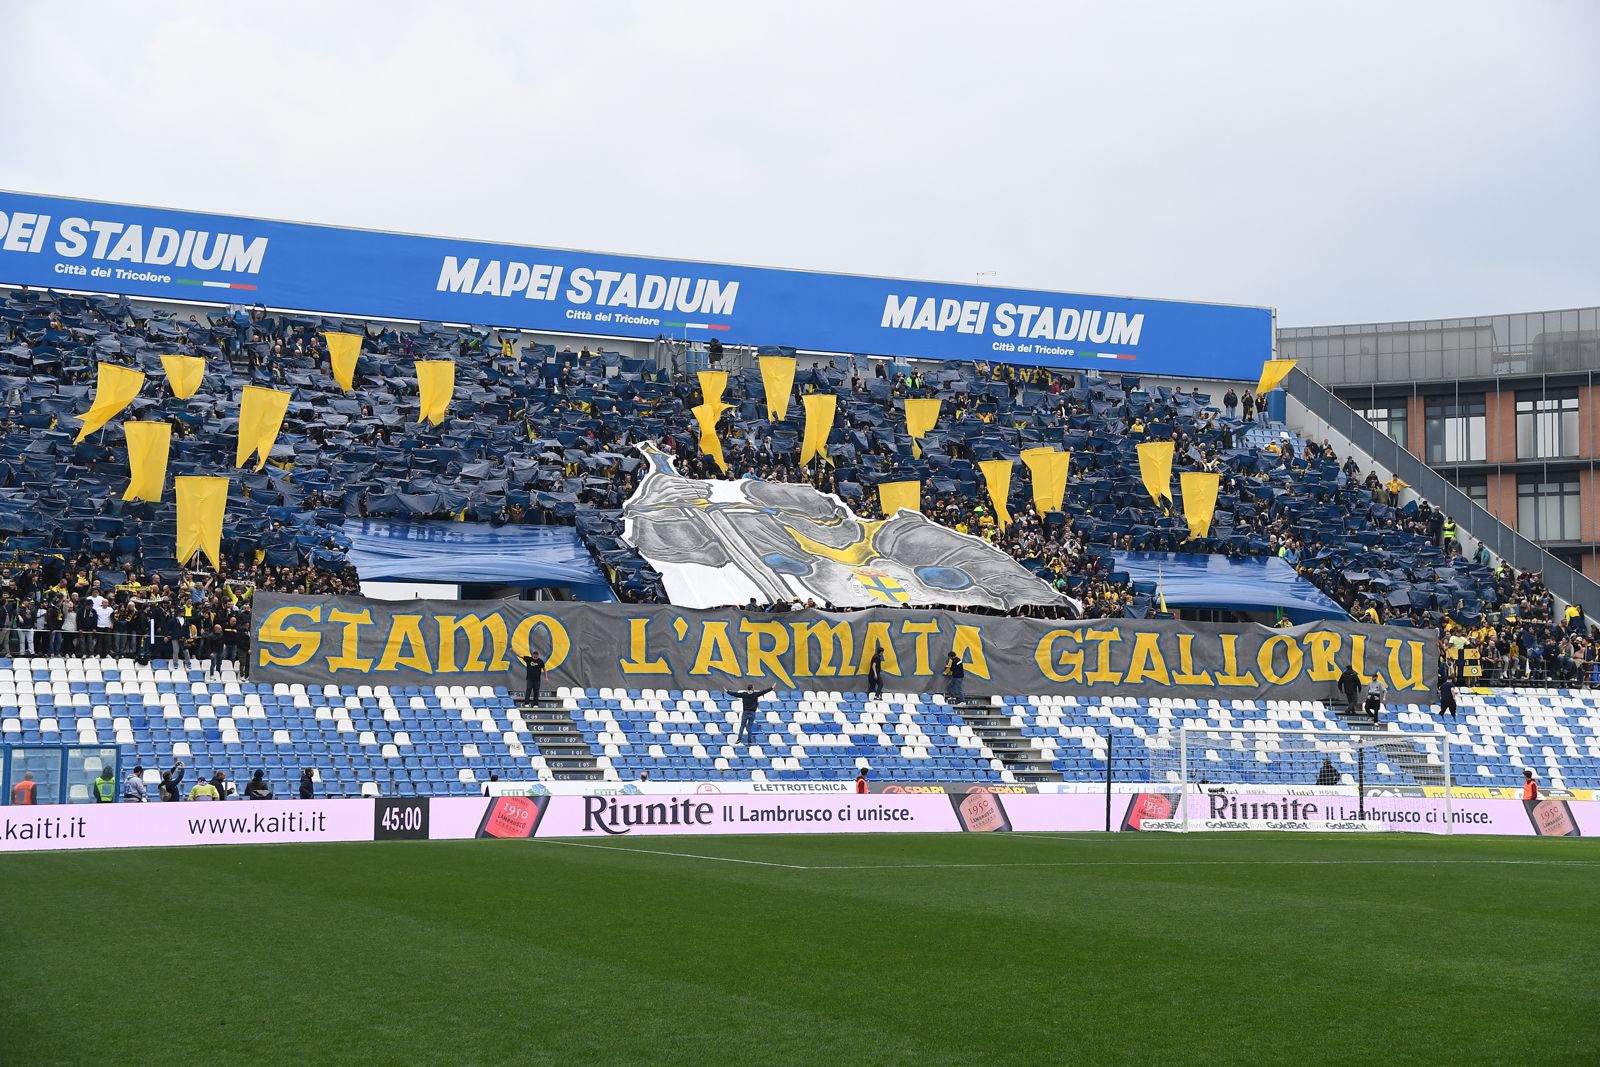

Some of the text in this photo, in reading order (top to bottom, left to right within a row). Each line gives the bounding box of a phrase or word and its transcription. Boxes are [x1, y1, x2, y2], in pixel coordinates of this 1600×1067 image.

[55, 216, 268, 275] STADIUM
[54, 263, 171, 284] Città del Tricolore
[436, 255, 740, 316] MAPEI STADIUM
[565, 309, 660, 327] Città del Tricolore
[881, 295, 1145, 346] MAPEI STADIUM
[992, 341, 1075, 357] Città del Tricolore
[257, 604, 1430, 692] SIAMO L'ARMATA GIALLOBLU
[753, 783, 848, 792] ELETTROTECNICA
[503, 803, 529, 819] 1950
[582, 795, 714, 835] Riunite
[723, 804, 914, 822] Il Lambrusco ci unisce.
[967, 800, 989, 816] 1950
[1207, 793, 1318, 820] Riunite
[1339, 806, 1421, 823] Lambrusco
[1425, 808, 1437, 823] ci
[187, 810, 327, 838] www.kaiti.it
[381, 806, 422, 831] 45:00
[1205, 821, 1250, 829] GoldBet
[1265, 821, 1310, 830] GoldBet
